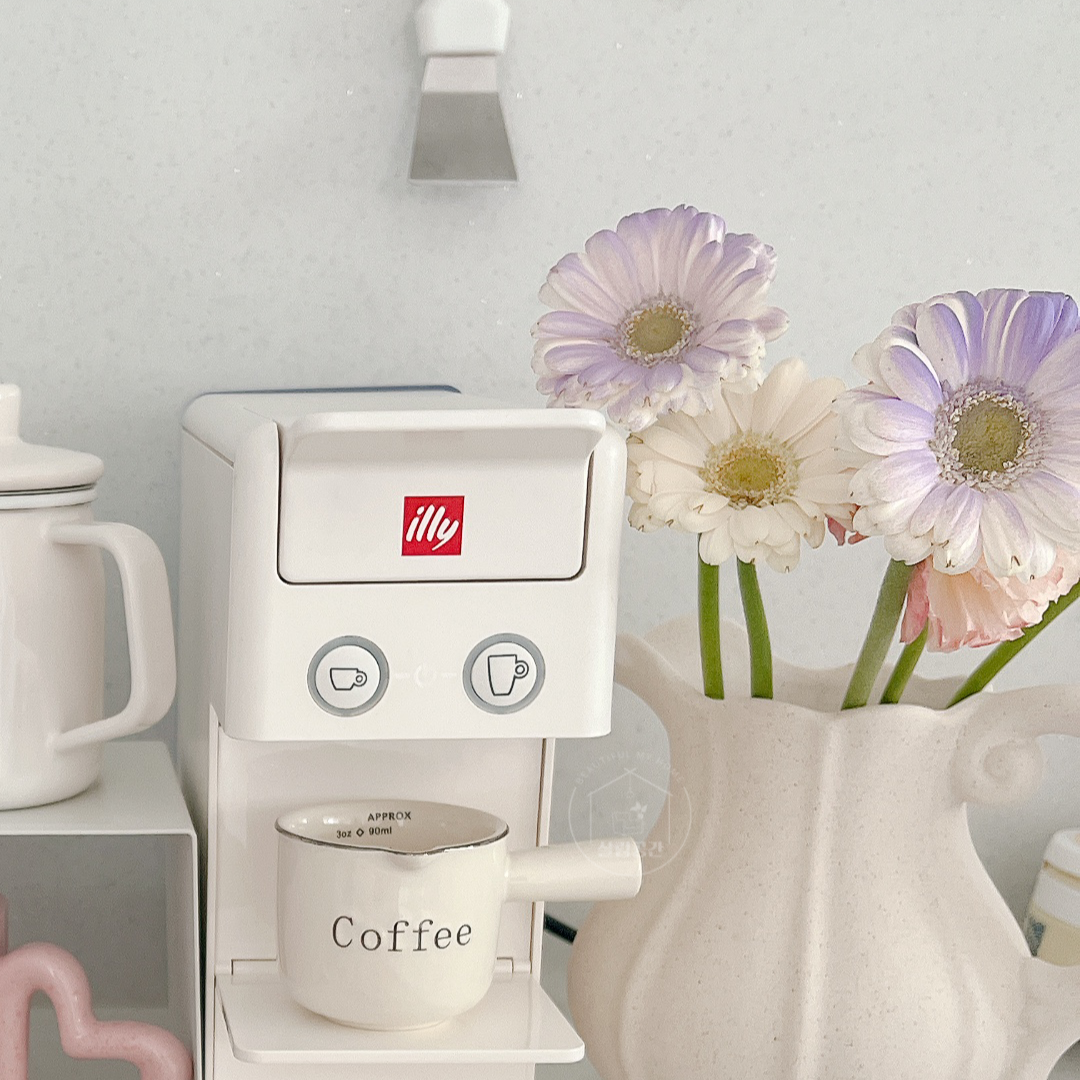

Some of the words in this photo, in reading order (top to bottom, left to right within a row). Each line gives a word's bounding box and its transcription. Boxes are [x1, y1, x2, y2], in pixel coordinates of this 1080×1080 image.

[405, 504, 460, 551] illy
[367, 811, 412, 822] APPROX
[336, 829, 352, 839] 3oz
[368, 826, 392, 836] 90ml
[332, 915, 473, 953] Coffee
